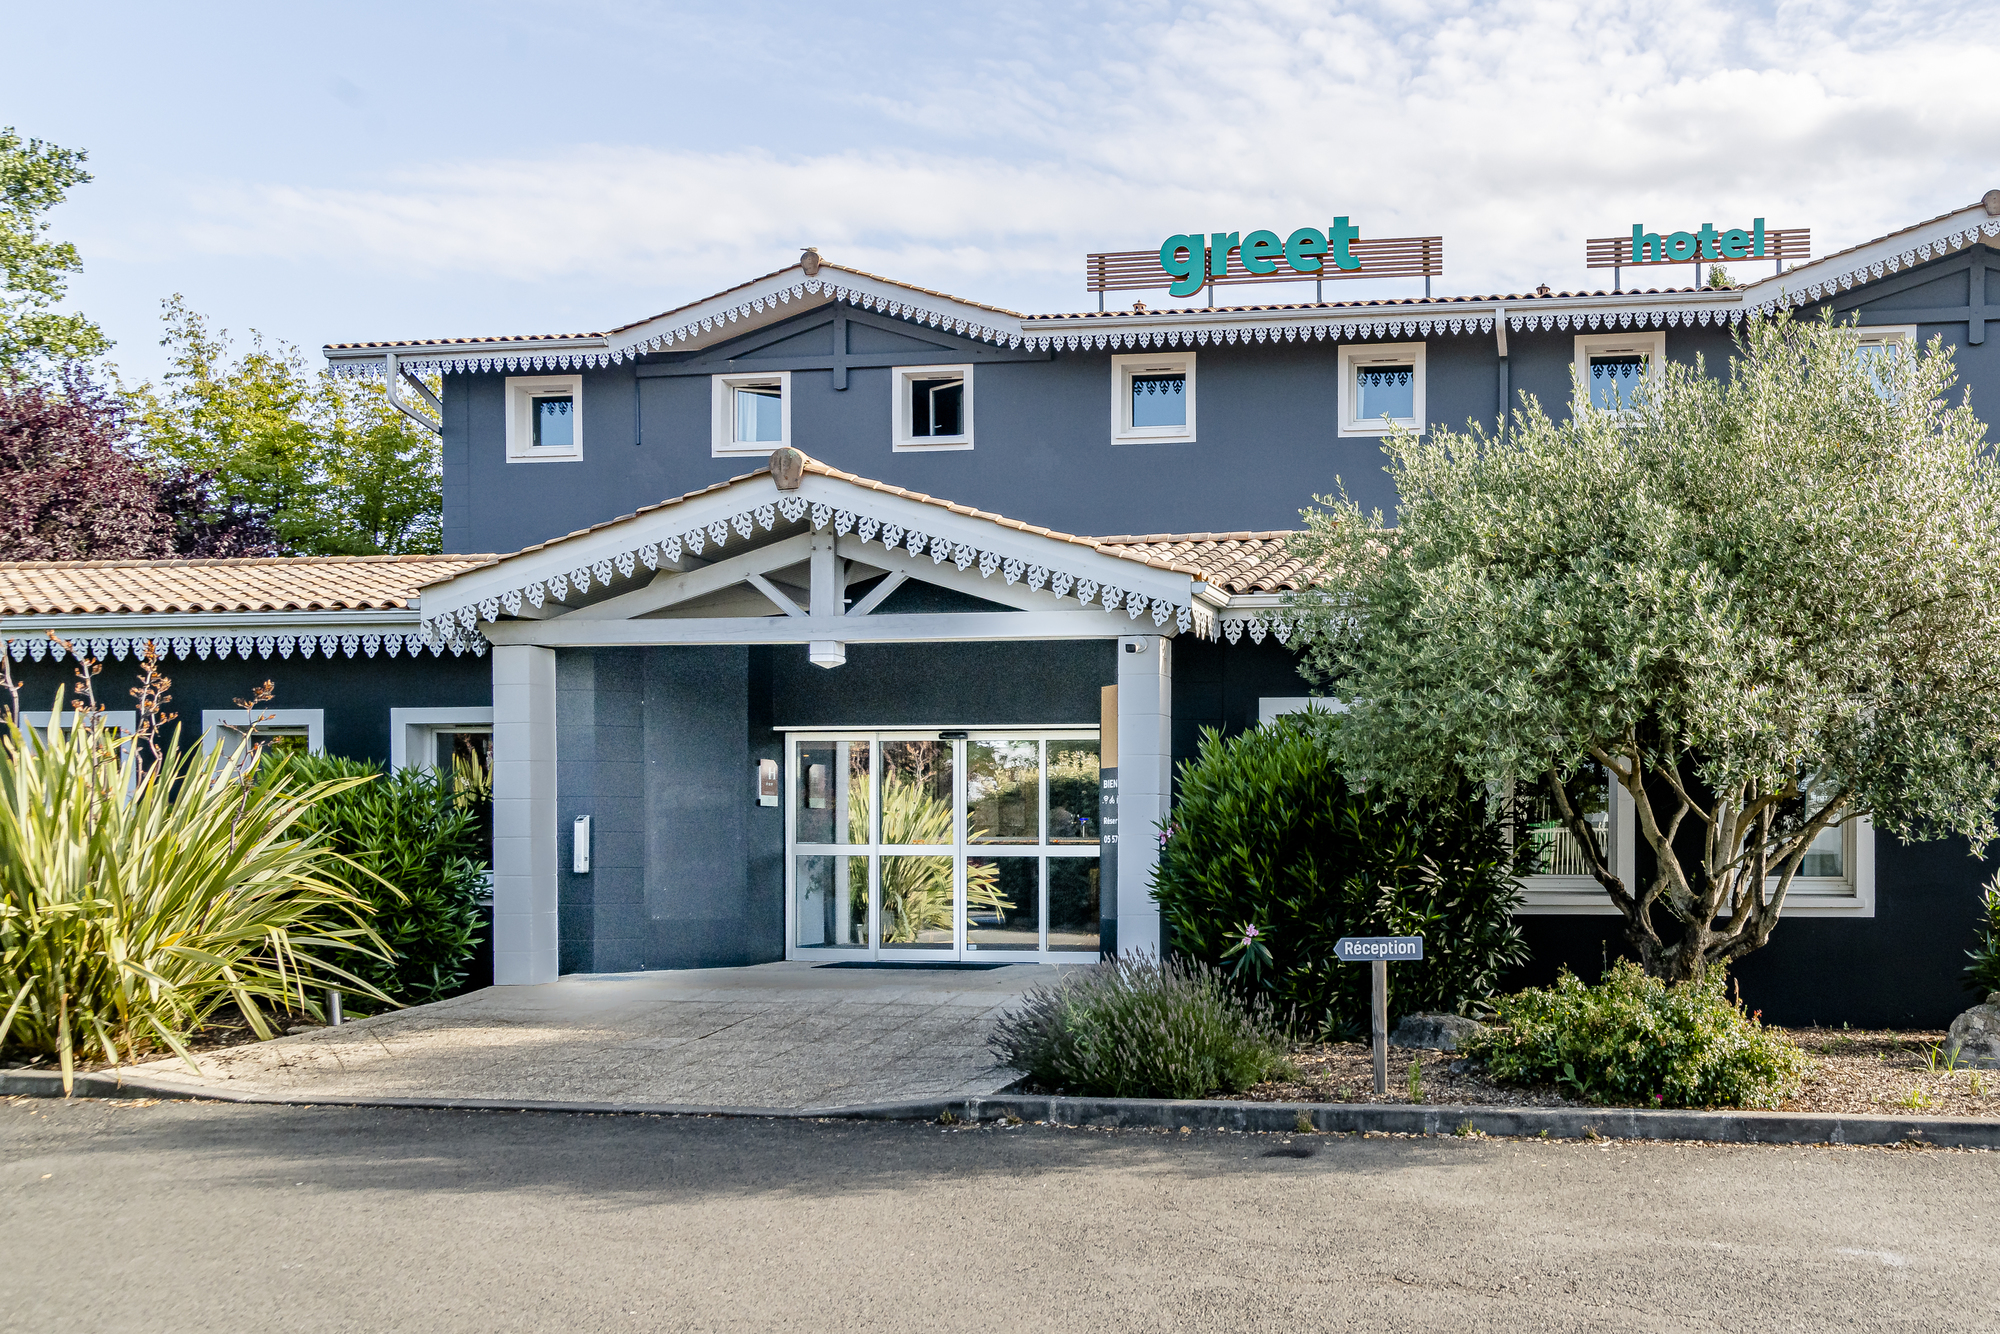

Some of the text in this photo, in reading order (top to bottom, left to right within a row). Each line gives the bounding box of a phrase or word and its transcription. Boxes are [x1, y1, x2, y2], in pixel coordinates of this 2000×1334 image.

[1632, 218, 1765, 262] hotel
[1159, 215, 1361, 298] greet
[768, 766, 776, 780] H
[1103, 835, 1111, 843] 05
[1344, 940, 1416, 958] Réception
